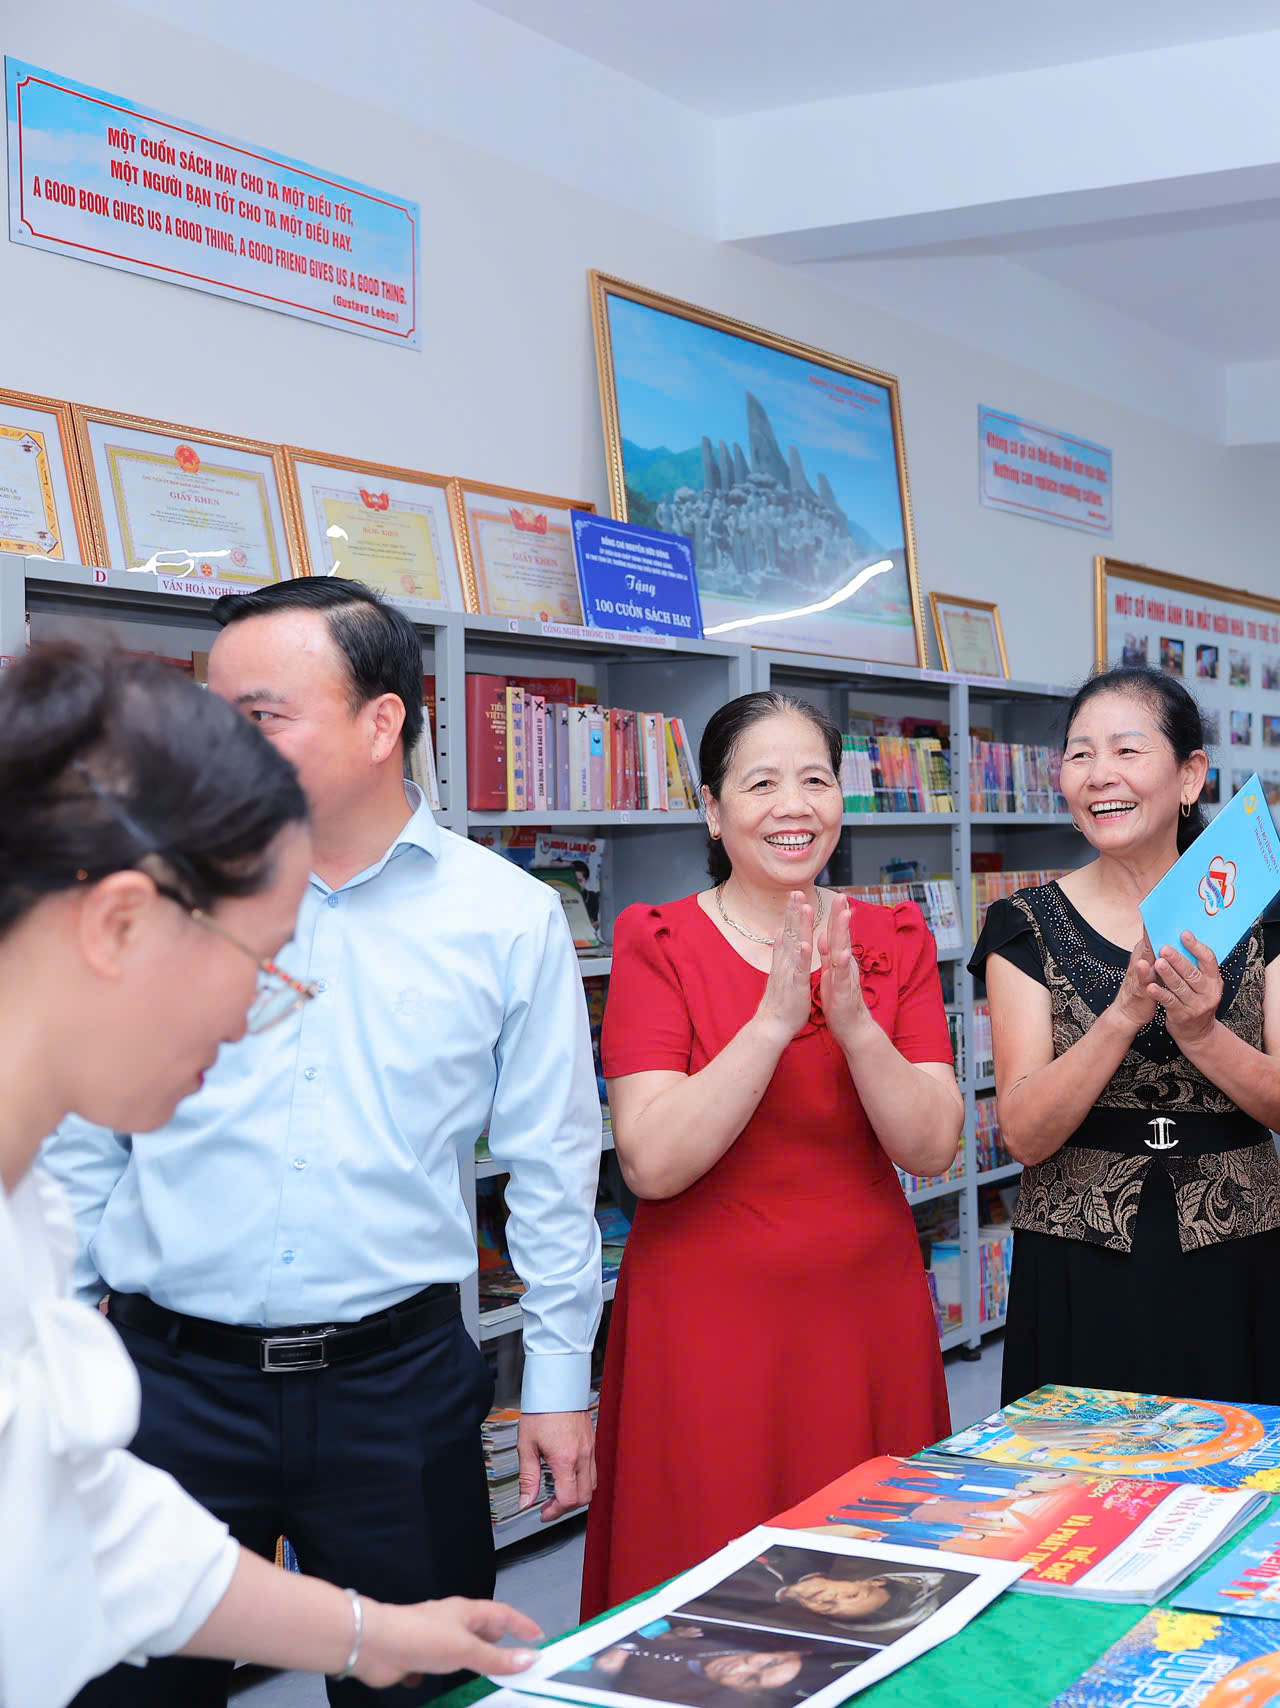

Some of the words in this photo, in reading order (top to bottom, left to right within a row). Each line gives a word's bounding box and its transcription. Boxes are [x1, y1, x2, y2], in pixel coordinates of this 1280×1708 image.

[108, 127, 136, 154] MỘT
[141, 138, 175, 166] CUỐN
[179, 150, 212, 178] SÁCH
[215, 162, 238, 187] HAY
[241, 171, 263, 195] CHO
[266, 180, 279, 200] TA
[282, 186, 305, 210] MỘT
[111, 159, 139, 187] MỘT
[143, 169, 182, 199] NGƯỜI
[186, 183, 211, 208] BẠN
[214, 189, 235, 215] TỐT
[239, 200, 261, 223] CHO
[264, 208, 276, 228] TA
[280, 214, 302, 238] MỘT
[332, 231, 353, 253] HAY.
[33, 175, 42, 198] A
[45, 179, 76, 207] GOOD
[79, 189, 110, 217] BOOK
[113, 200, 145, 228] GIVES
[147, 209, 162, 232] US
[165, 215, 173, 235] A
[175, 217, 202, 244] GOOD
[205, 226, 237, 256] THING,
[240, 237, 246, 256] A
[249, 240, 273, 264] GOOD
[276, 248, 307, 275] FRIEND
[309, 259, 334, 283] GIVES
[336, 267, 347, 287] US
[350, 271, 355, 289] A
[357, 274, 379, 297] GOOD
[381, 280, 408, 305] THING.
[95, 570, 107, 583] D
[162, 580, 183, 592] VĂN
[624, 573, 656, 598] Tặng
[595, 598, 614, 613] 100
[615, 599, 643, 619] CUỐN
[645, 606, 671, 624] SÁCH
[672, 614, 692, 628] HAY
[509, 620, 517, 632] C
[1062, 1514, 1095, 1527] VÀ
[1035, 1527, 1079, 1552] PHÁT
